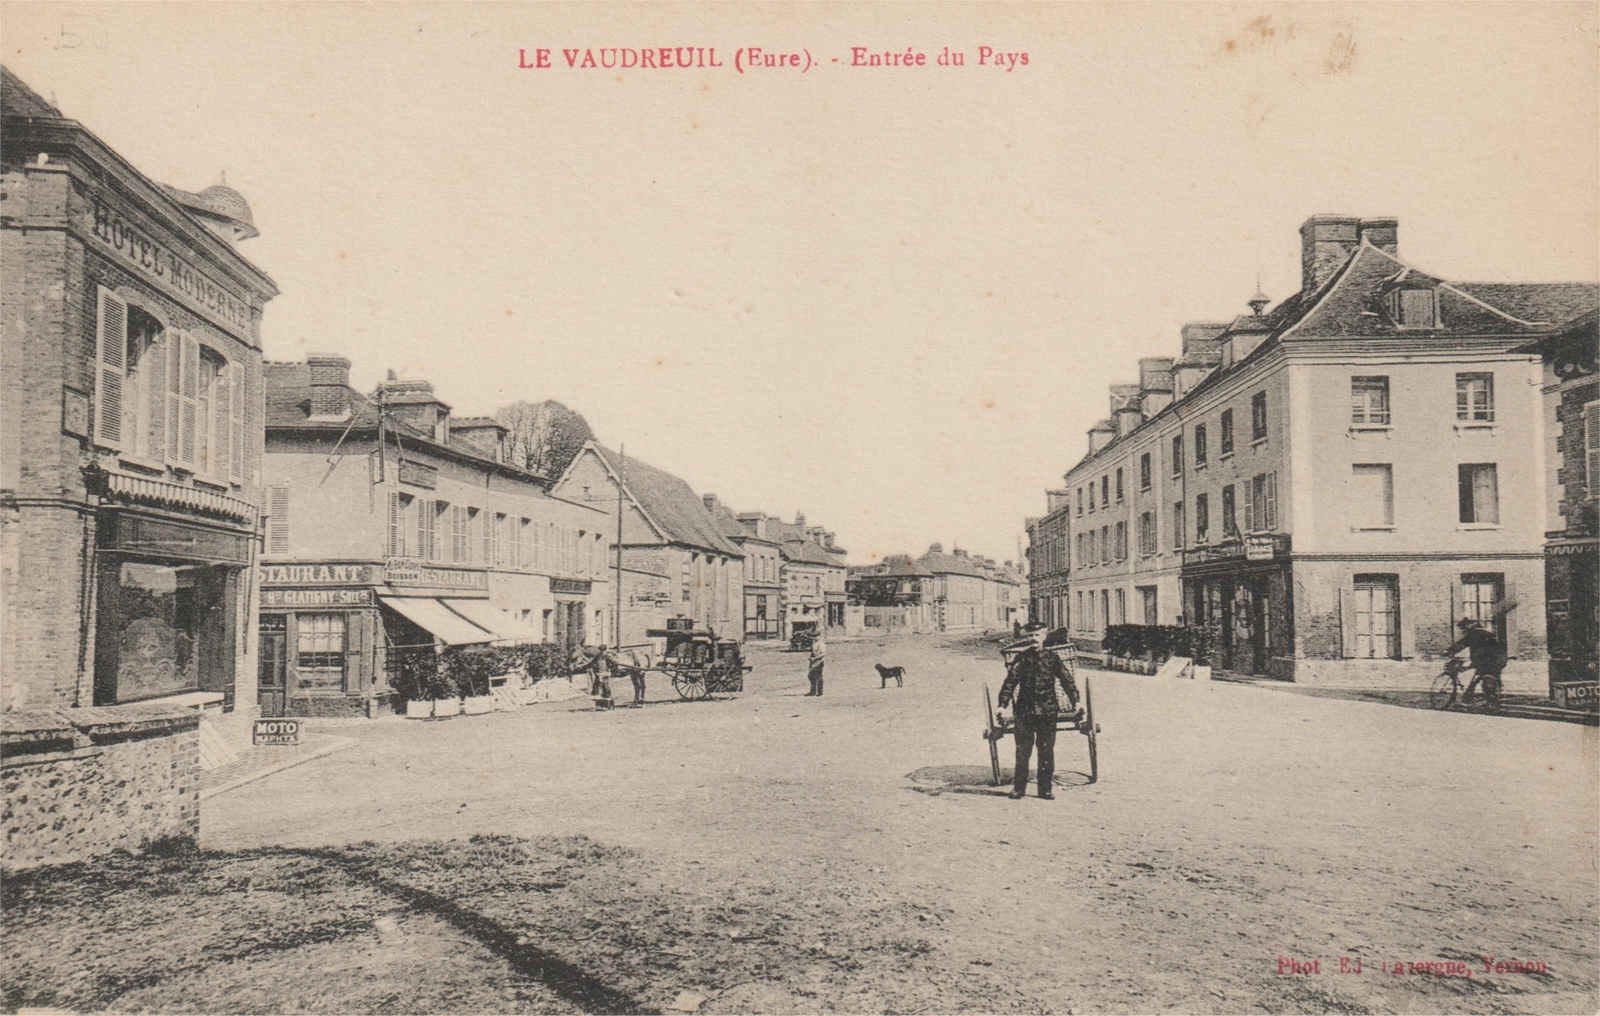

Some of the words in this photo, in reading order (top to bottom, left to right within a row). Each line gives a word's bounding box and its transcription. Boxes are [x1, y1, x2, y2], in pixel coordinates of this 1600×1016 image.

[92, 201, 164, 276] HOTEL
[168, 254, 246, 329] MODERNE
[387, 571, 419, 580] BOISSON
[418, 568, 482, 586] RESTAURANT
[284, 590, 335, 604] GLATIGNY
[256, 722, 298, 734] MOTO
